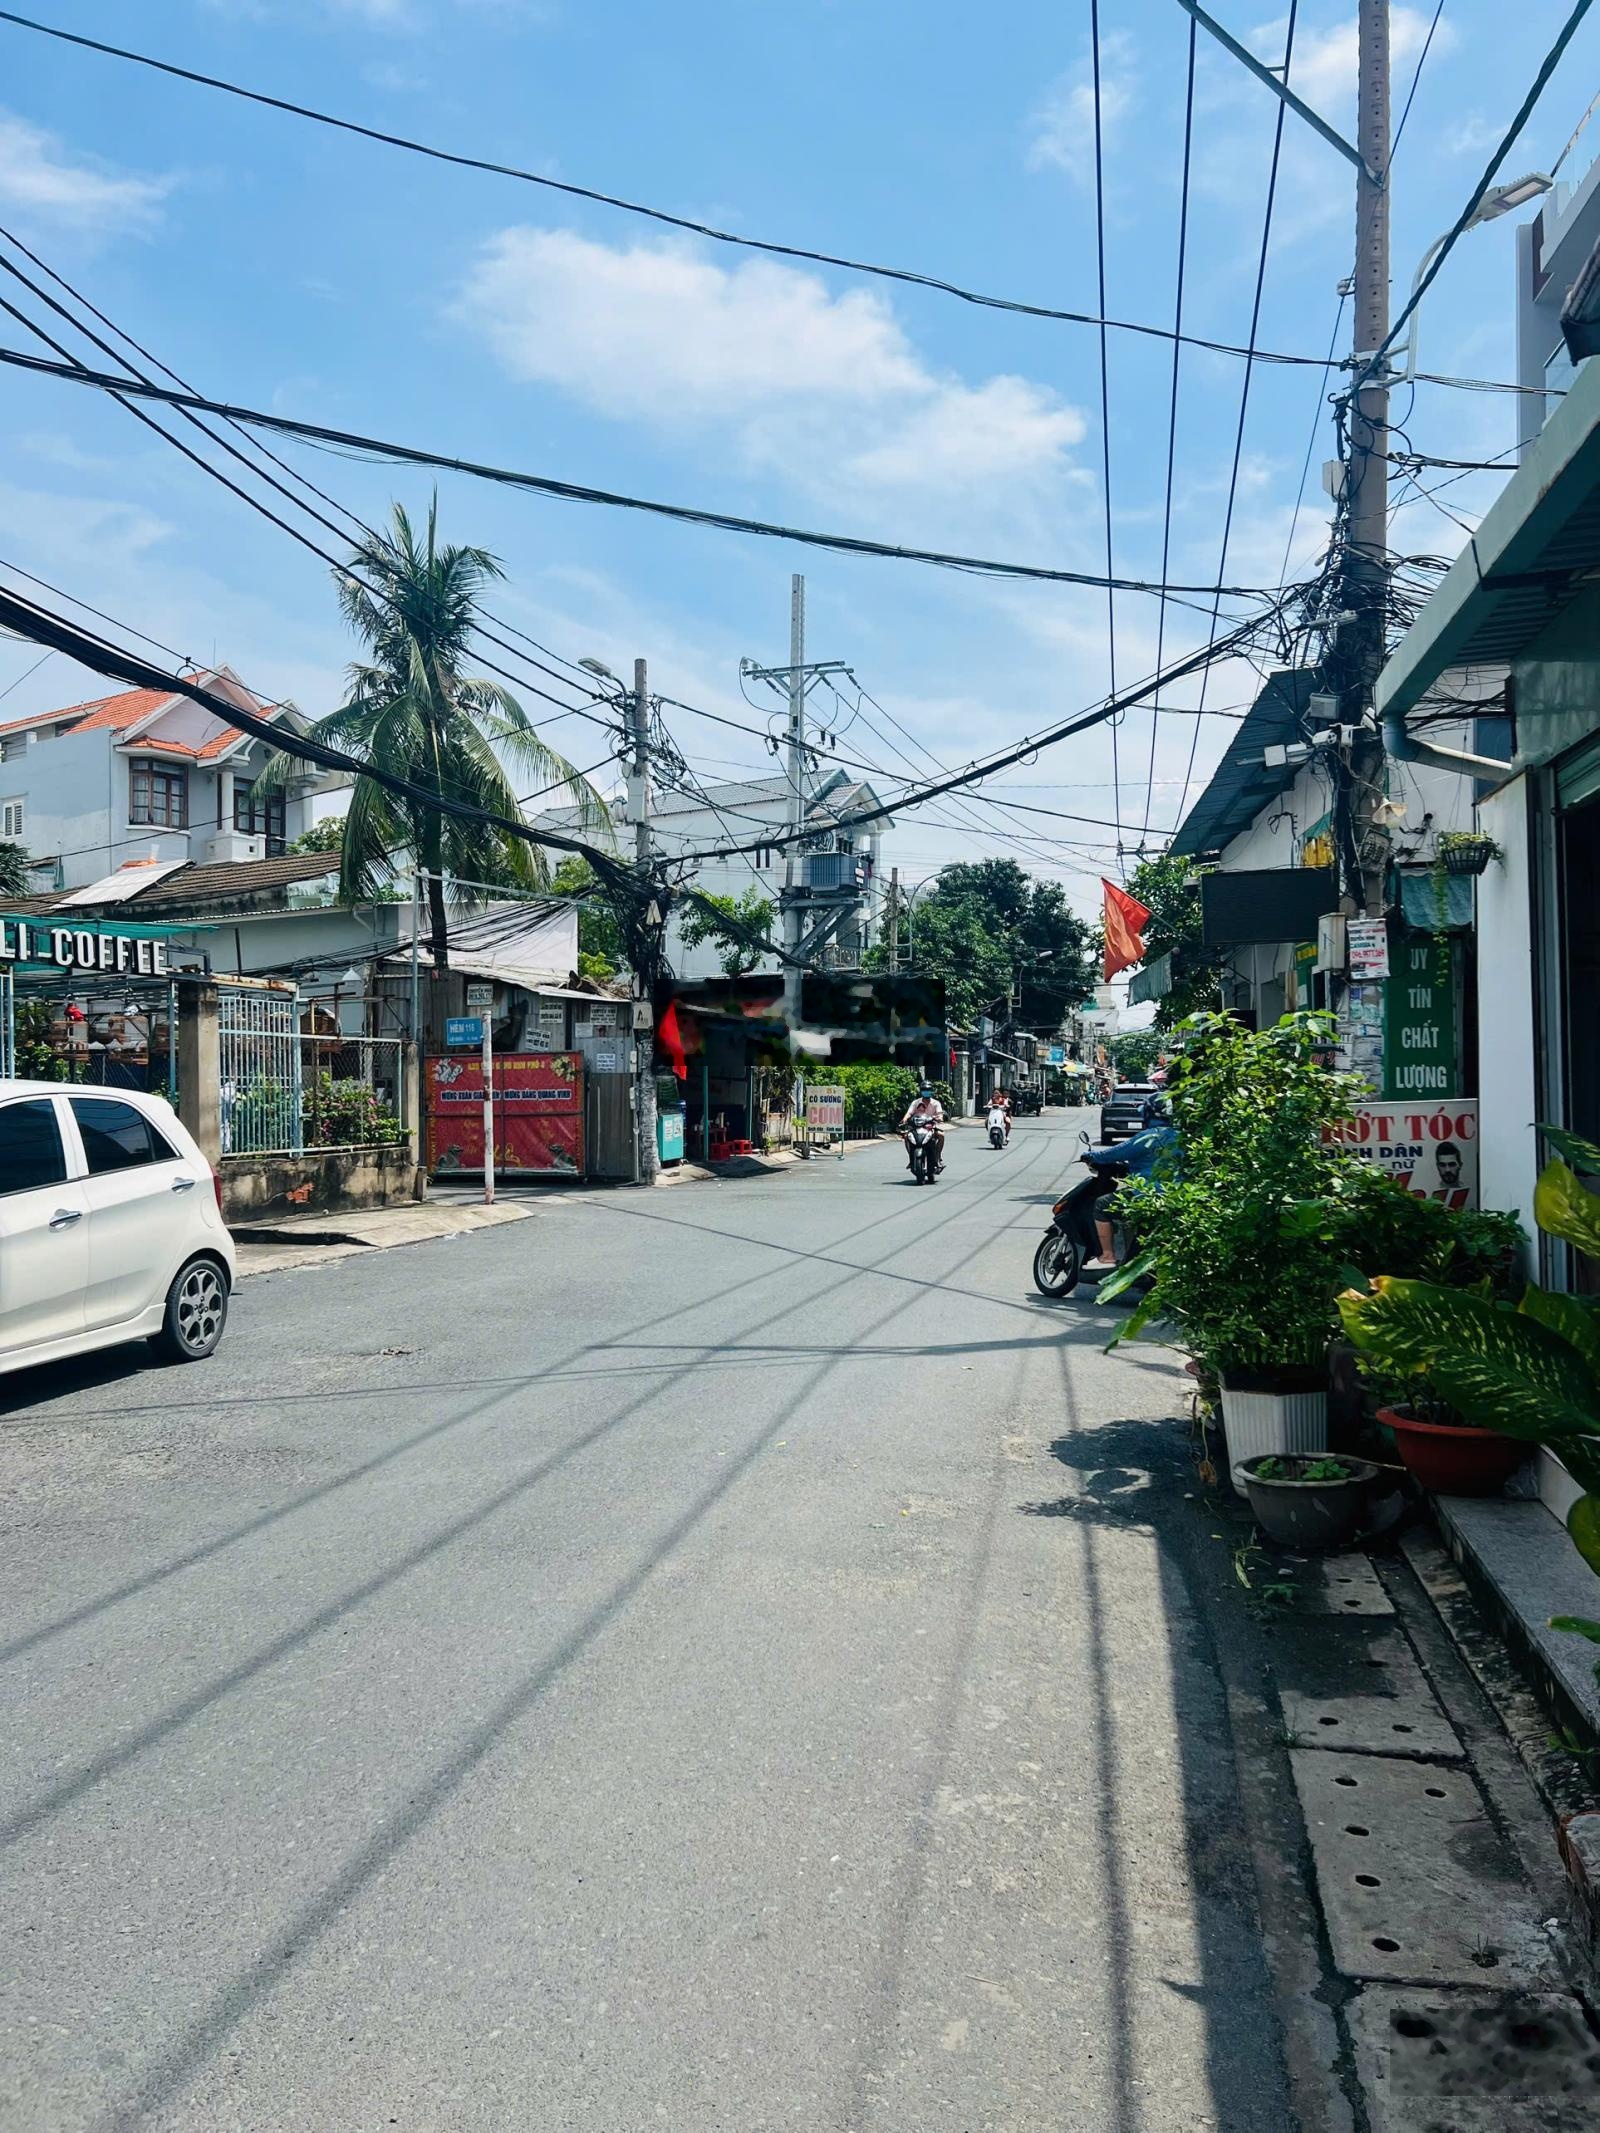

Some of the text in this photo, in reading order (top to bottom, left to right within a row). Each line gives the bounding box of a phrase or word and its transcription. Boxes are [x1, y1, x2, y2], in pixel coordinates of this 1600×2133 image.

[52, 928, 168, 975] COFFEE
[1408, 984, 1432, 1008] TÍN
[1401, 1020, 1439, 1048] CHẤT
[1395, 1064, 1447, 1093] LƯỢNG
[1321, 1106, 1475, 1143] HỚT TÓC
[1380, 1142, 1423, 1158] DÂN
[1392, 1158, 1416, 1169] nữ
